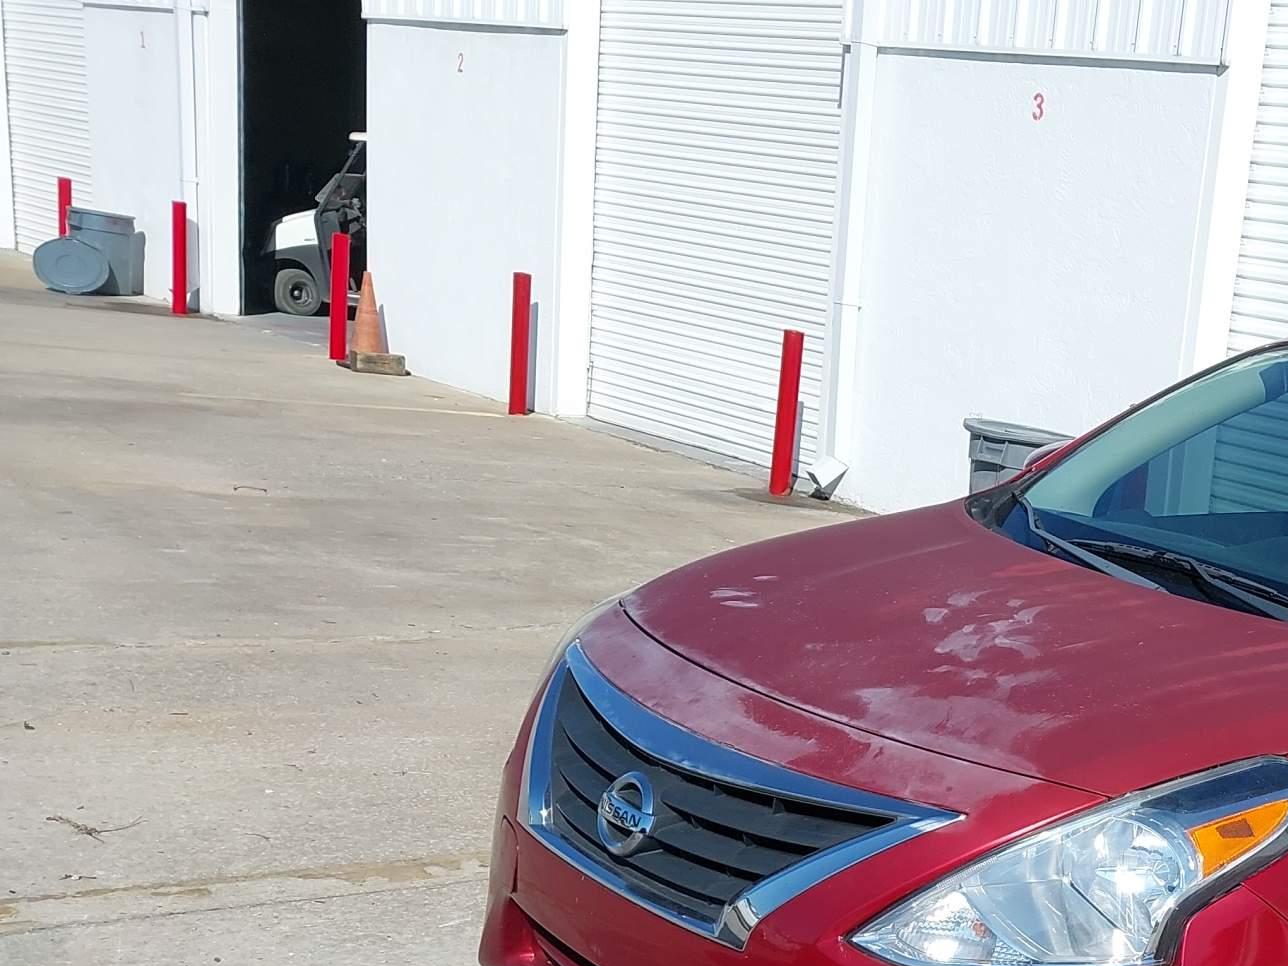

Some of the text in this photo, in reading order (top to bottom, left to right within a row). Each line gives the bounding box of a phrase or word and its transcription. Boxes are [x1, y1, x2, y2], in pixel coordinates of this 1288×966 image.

[139, 31, 147, 49] 1
[457, 52, 464, 73] 2
[1032, 92, 1045, 121] 3
